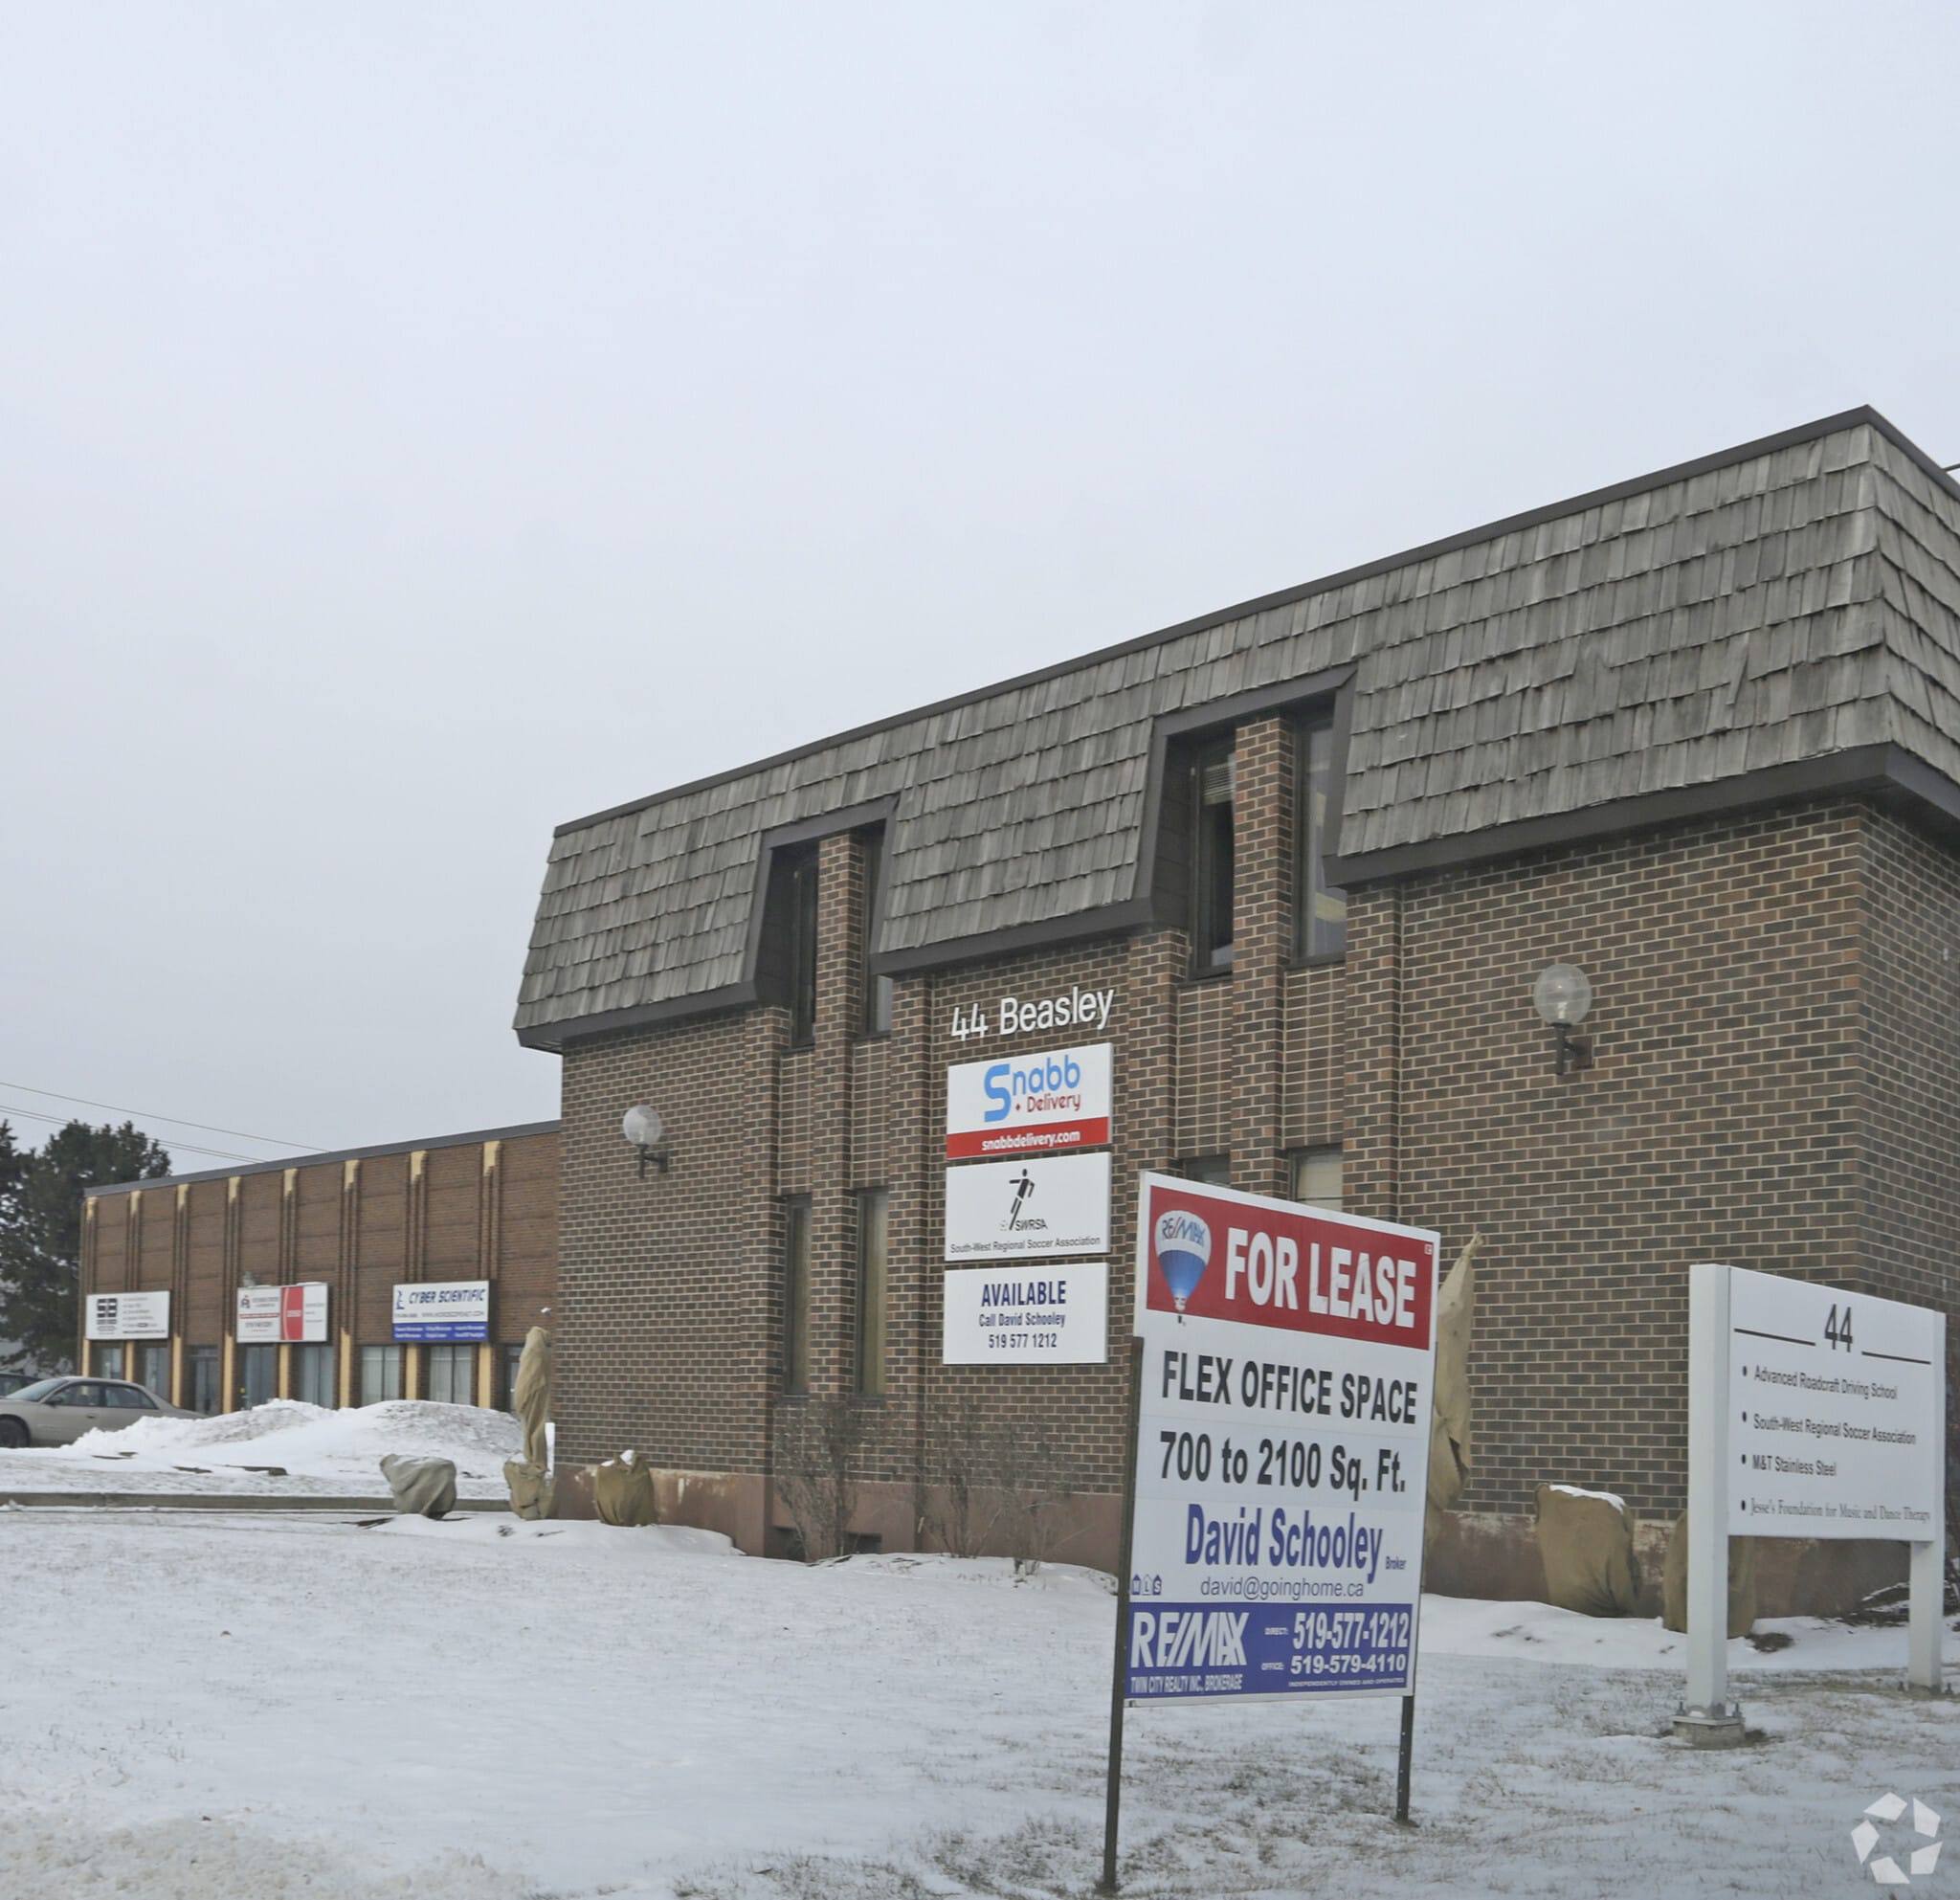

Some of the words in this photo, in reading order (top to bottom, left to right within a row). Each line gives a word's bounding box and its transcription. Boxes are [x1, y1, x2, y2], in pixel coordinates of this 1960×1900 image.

[950, 1003, 989, 1041] 44
[999, 986, 1114, 1036] Beasley
[984, 1055, 1080, 1123] Snabb
[1027, 1093, 1080, 1112] Delivery
[982, 1130, 1080, 1151] snabbdelivery.com
[1014, 1218, 1048, 1232] SWRSA
[950, 1242, 991, 1253] South-West
[992, 1240, 1025, 1253] Regional
[1027, 1239, 1054, 1249] Soccer
[1055, 1235, 1101, 1246] Association
[1224, 1226, 1299, 1310] FOR
[1308, 1242, 1416, 1329] LEASE
[409, 1291, 436, 1304] CYBER
[438, 1288, 485, 1303] SCIENTIFIC
[981, 1280, 1066, 1307] AVAILABLE
[979, 1313, 996, 1327] Call
[998, 1312, 1023, 1326] David
[1025, 1311, 1065, 1328] Schooley
[1824, 1304, 1853, 1352] 44
[989, 1333, 1007, 1348] 519
[1010, 1333, 1028, 1348] 577
[1032, 1332, 1057, 1348] 1212
[1162, 1351, 1233, 1405] FLEX
[1241, 1360, 1332, 1416] OFFICE
[1340, 1373, 1417, 1425] SPACE
[1753, 1365, 1797, 1387] Advanced
[1799, 1373, 1839, 1393] Roadcraft
[1841, 1378, 1869, 1399] Driving
[1871, 1382, 1898, 1399] School
[1753, 1413, 1803, 1433] South-West
[1805, 1419, 1841, 1439] Regional
[1842, 1422, 1871, 1441] Soccer
[1872, 1427, 1917, 1444] Association
[1160, 1430, 1212, 1481] 700
[1221, 1437, 1248, 1484] to
[1257, 1438, 1321, 1487] 2100
[1329, 1444, 1368, 1502] Sq.
[1376, 1448, 1406, 1492] Ft.
[1774, 1456, 1814, 1475] Stainless
[1815, 1460, 1837, 1476] Steel
[1778, 1499, 1823, 1516] Foundation
[1825, 1502, 1838, 1517] for
[1862, 1505, 1877, 1520] and
[1185, 1503, 1262, 1566] David
[1268, 1508, 1383, 1584] Schooley
[1386, 1555, 1407, 1570] Broker
[1200, 1576, 1364, 1600] david@goinghome.ca
[1130, 1612, 1250, 1669] RE/MAX
[1293, 1612, 1410, 1649] 519-577-1212
[1290, 1654, 1407, 1674] 519-579-4110
[1131, 1676, 1148, 1693] TWIN
[1148, 1676, 1164, 1693] CITY
[1164, 1675, 1189, 1692] REALTY
[1205, 1673, 1243, 1691] BROKERAGE
